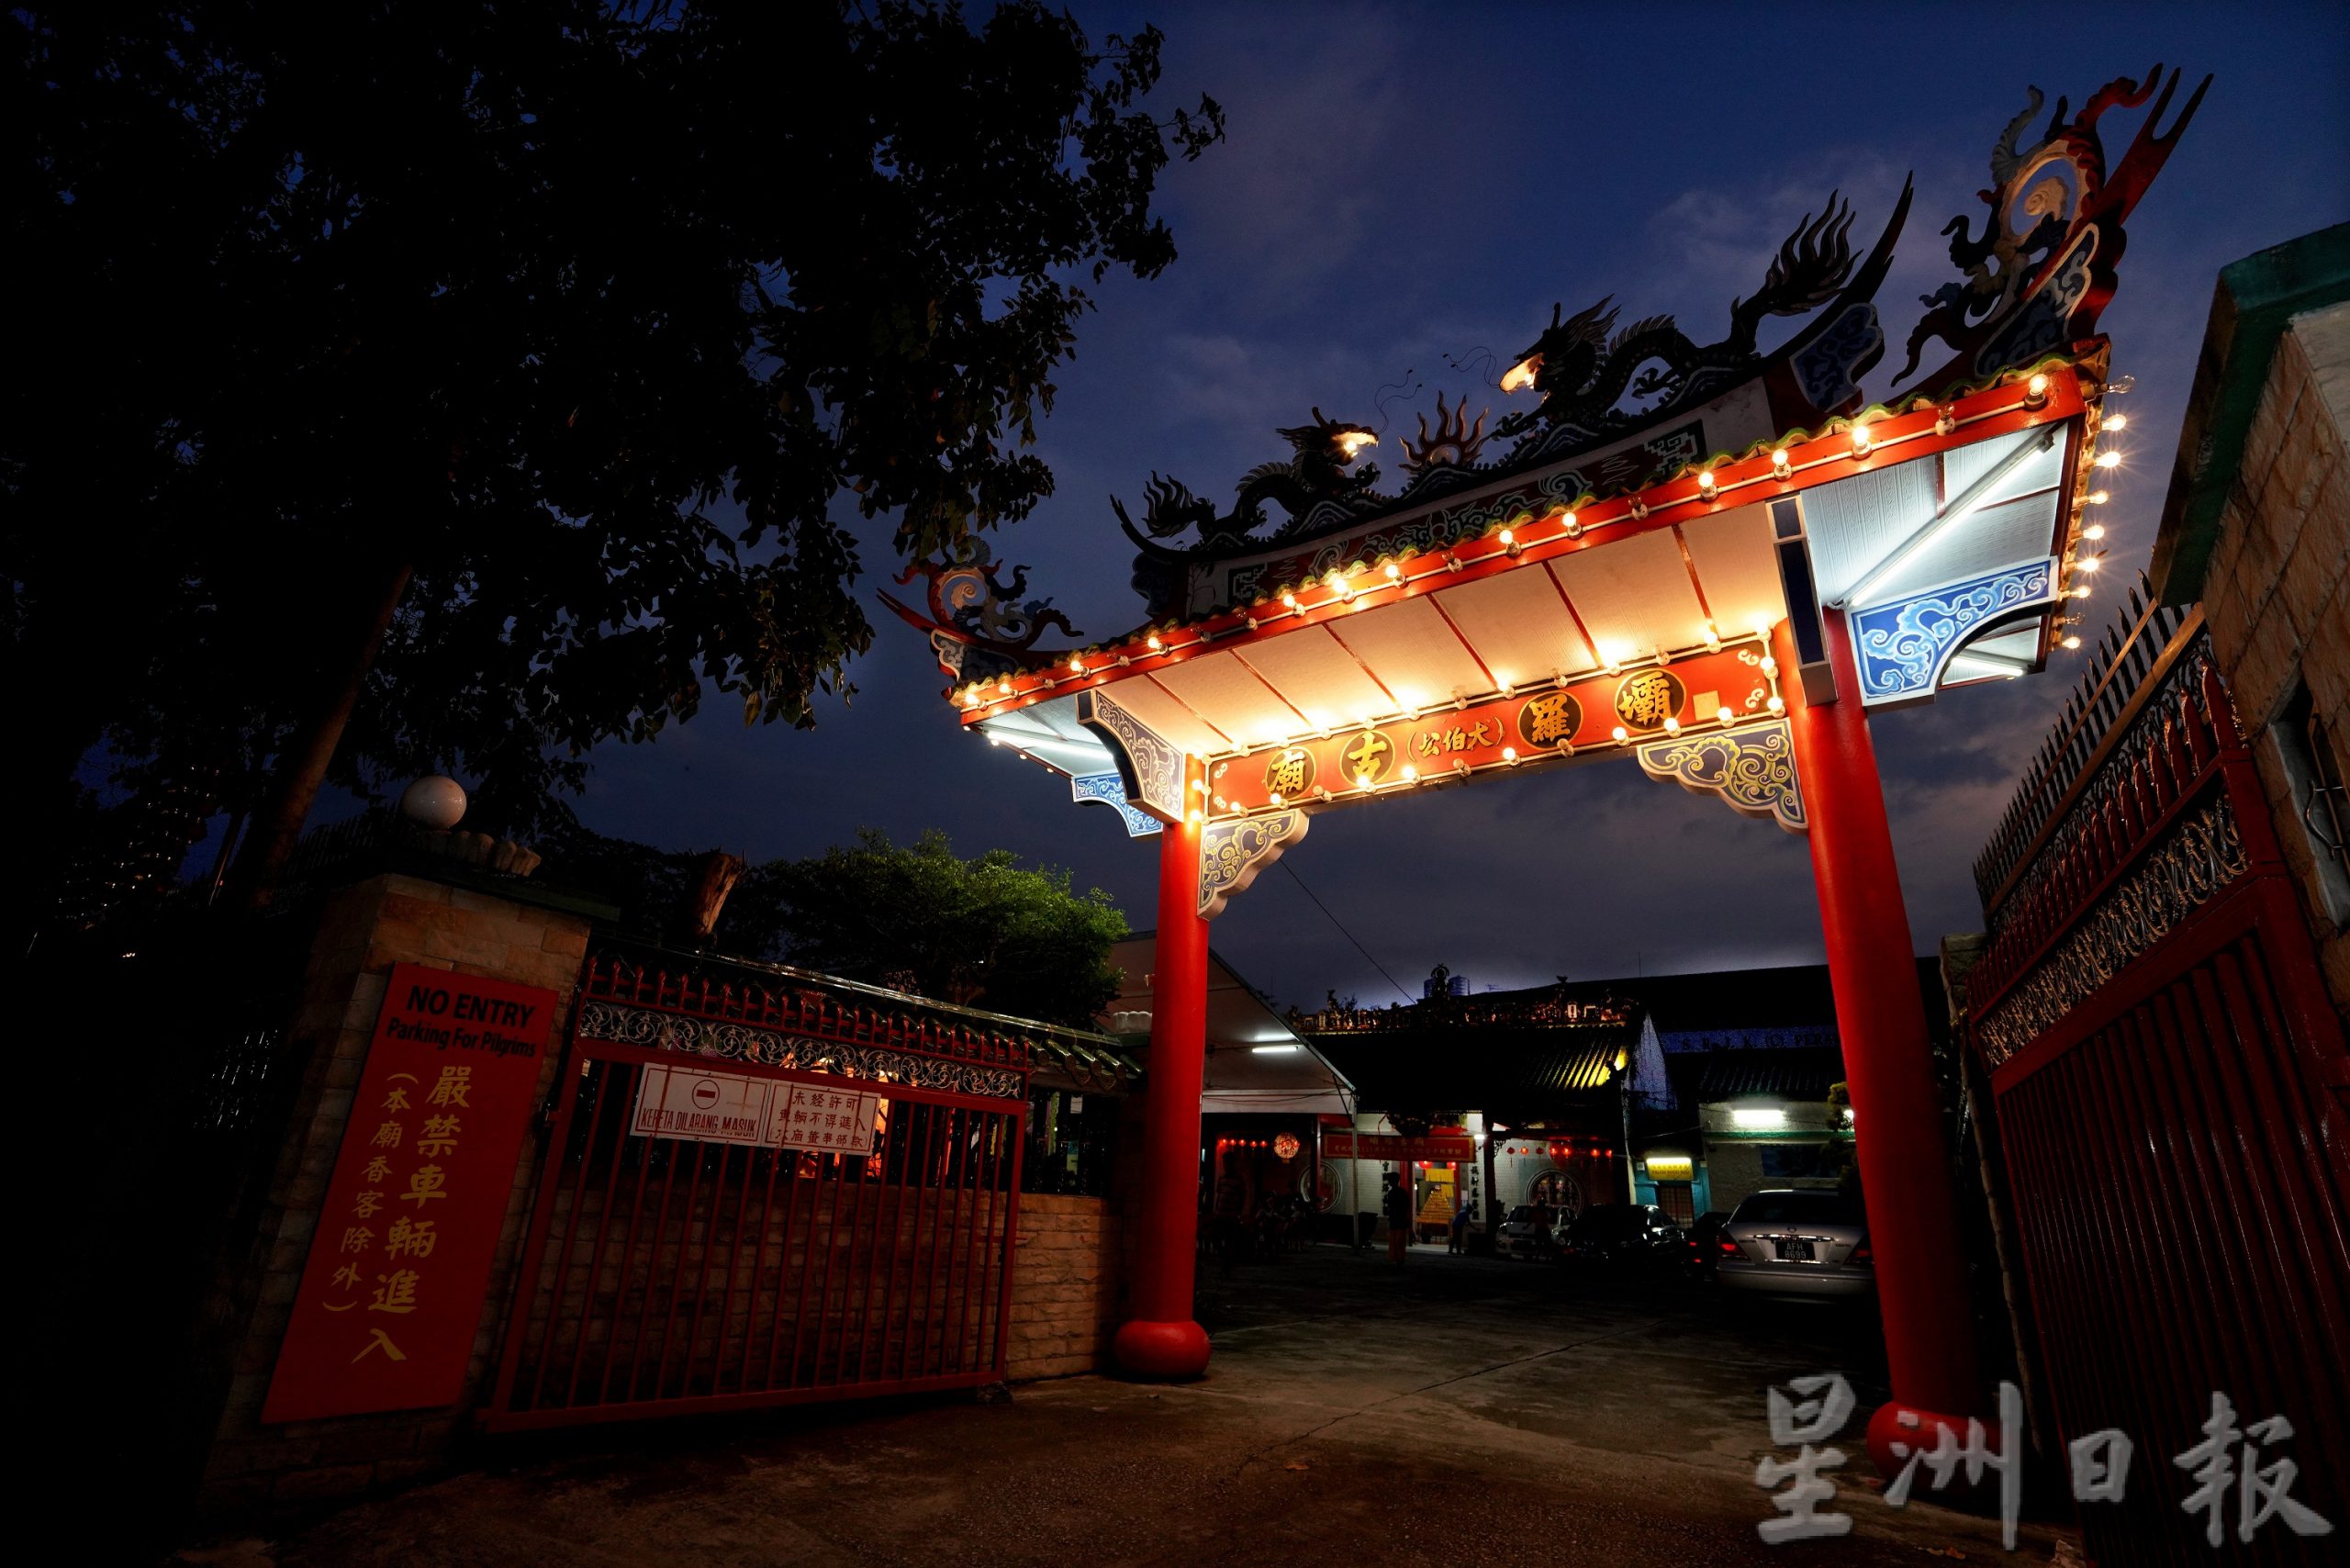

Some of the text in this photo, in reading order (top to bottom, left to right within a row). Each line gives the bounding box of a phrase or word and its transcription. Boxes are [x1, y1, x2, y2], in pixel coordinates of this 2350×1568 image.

[407, 984, 536, 1029] NO ENTRY
[386, 1016, 537, 1058] Parking For Pilgrims
[675, 1110, 719, 1134] DILARANG
[720, 1115, 757, 1137] MASUK
[351, 1065, 471, 1364] 嚴禁車輛進入
